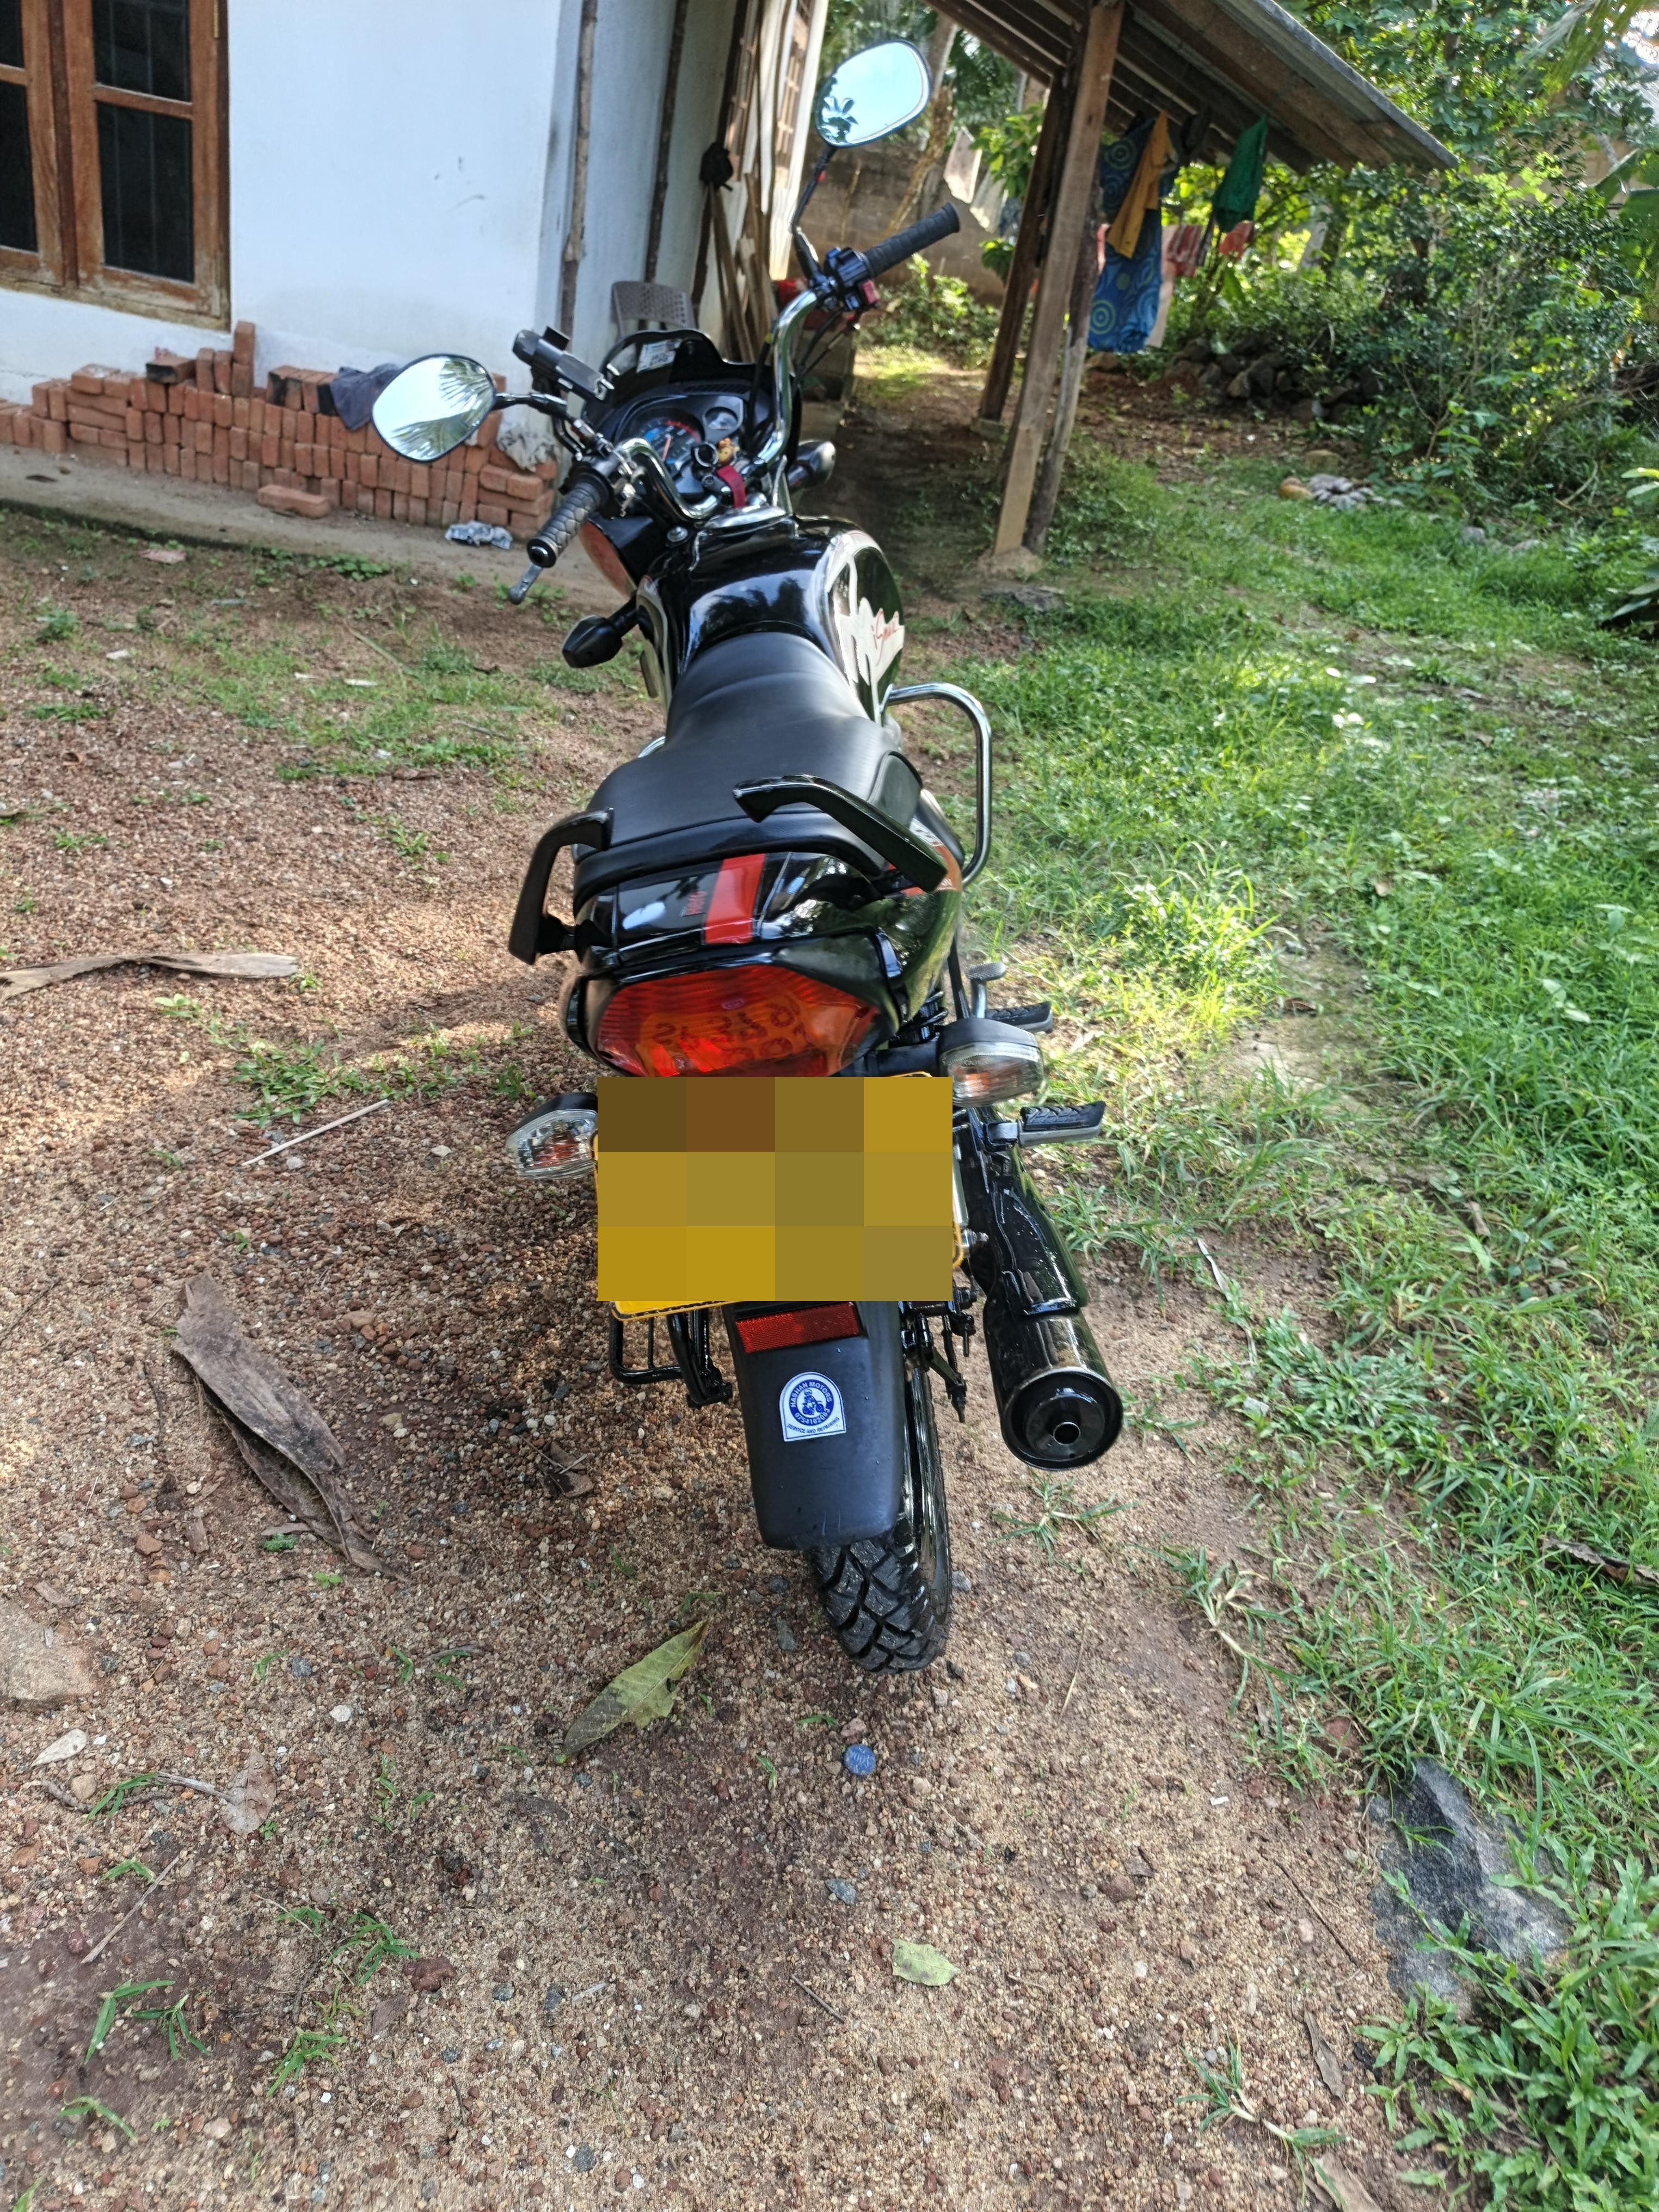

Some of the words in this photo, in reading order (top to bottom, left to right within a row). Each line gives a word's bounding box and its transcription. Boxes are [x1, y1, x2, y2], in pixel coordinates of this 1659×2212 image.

[809, 1381, 833, 1403] MOTORS
[787, 1423, 806, 1433] SERVICE
[817, 1417, 840, 1433] REPAIRING
